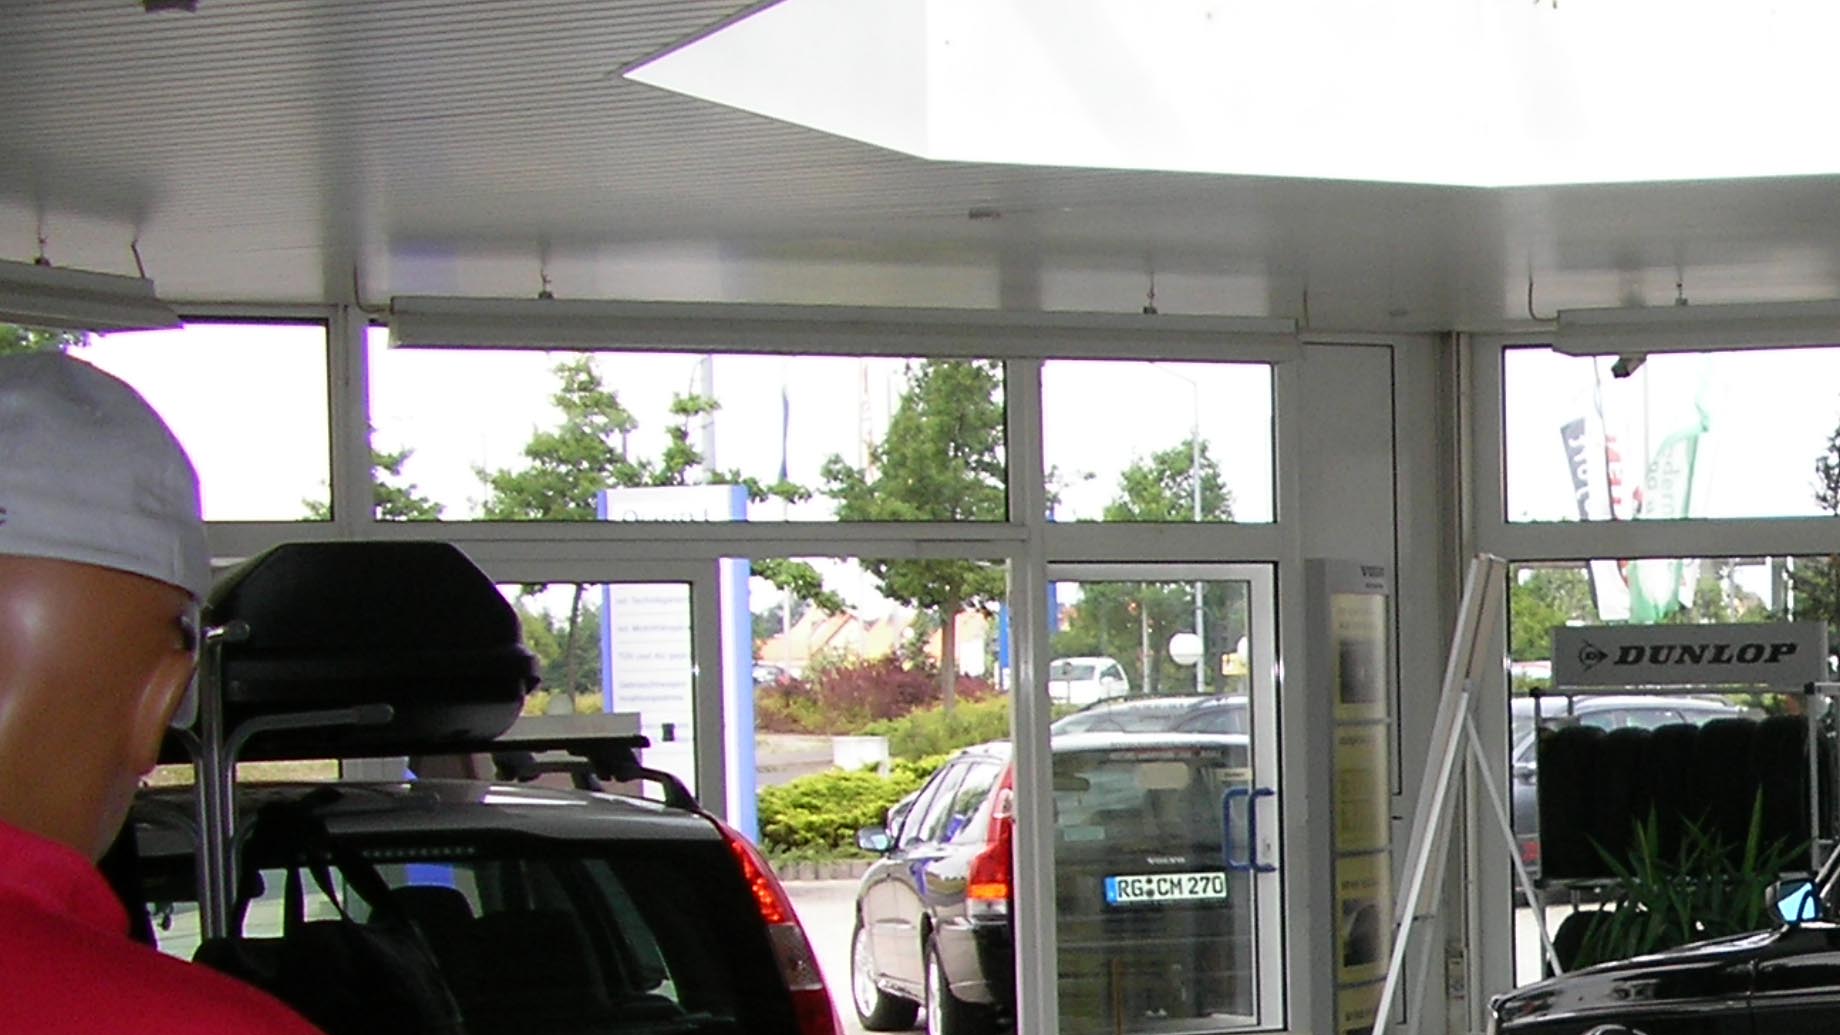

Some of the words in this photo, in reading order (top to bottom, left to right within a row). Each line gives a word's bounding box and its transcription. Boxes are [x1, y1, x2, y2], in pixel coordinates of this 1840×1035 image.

[1613, 642, 1798, 666] DUNLOP
[1117, 879, 1145, 898] RG
[1156, 877, 1184, 896] CM
[1188, 875, 1225, 895] 270
